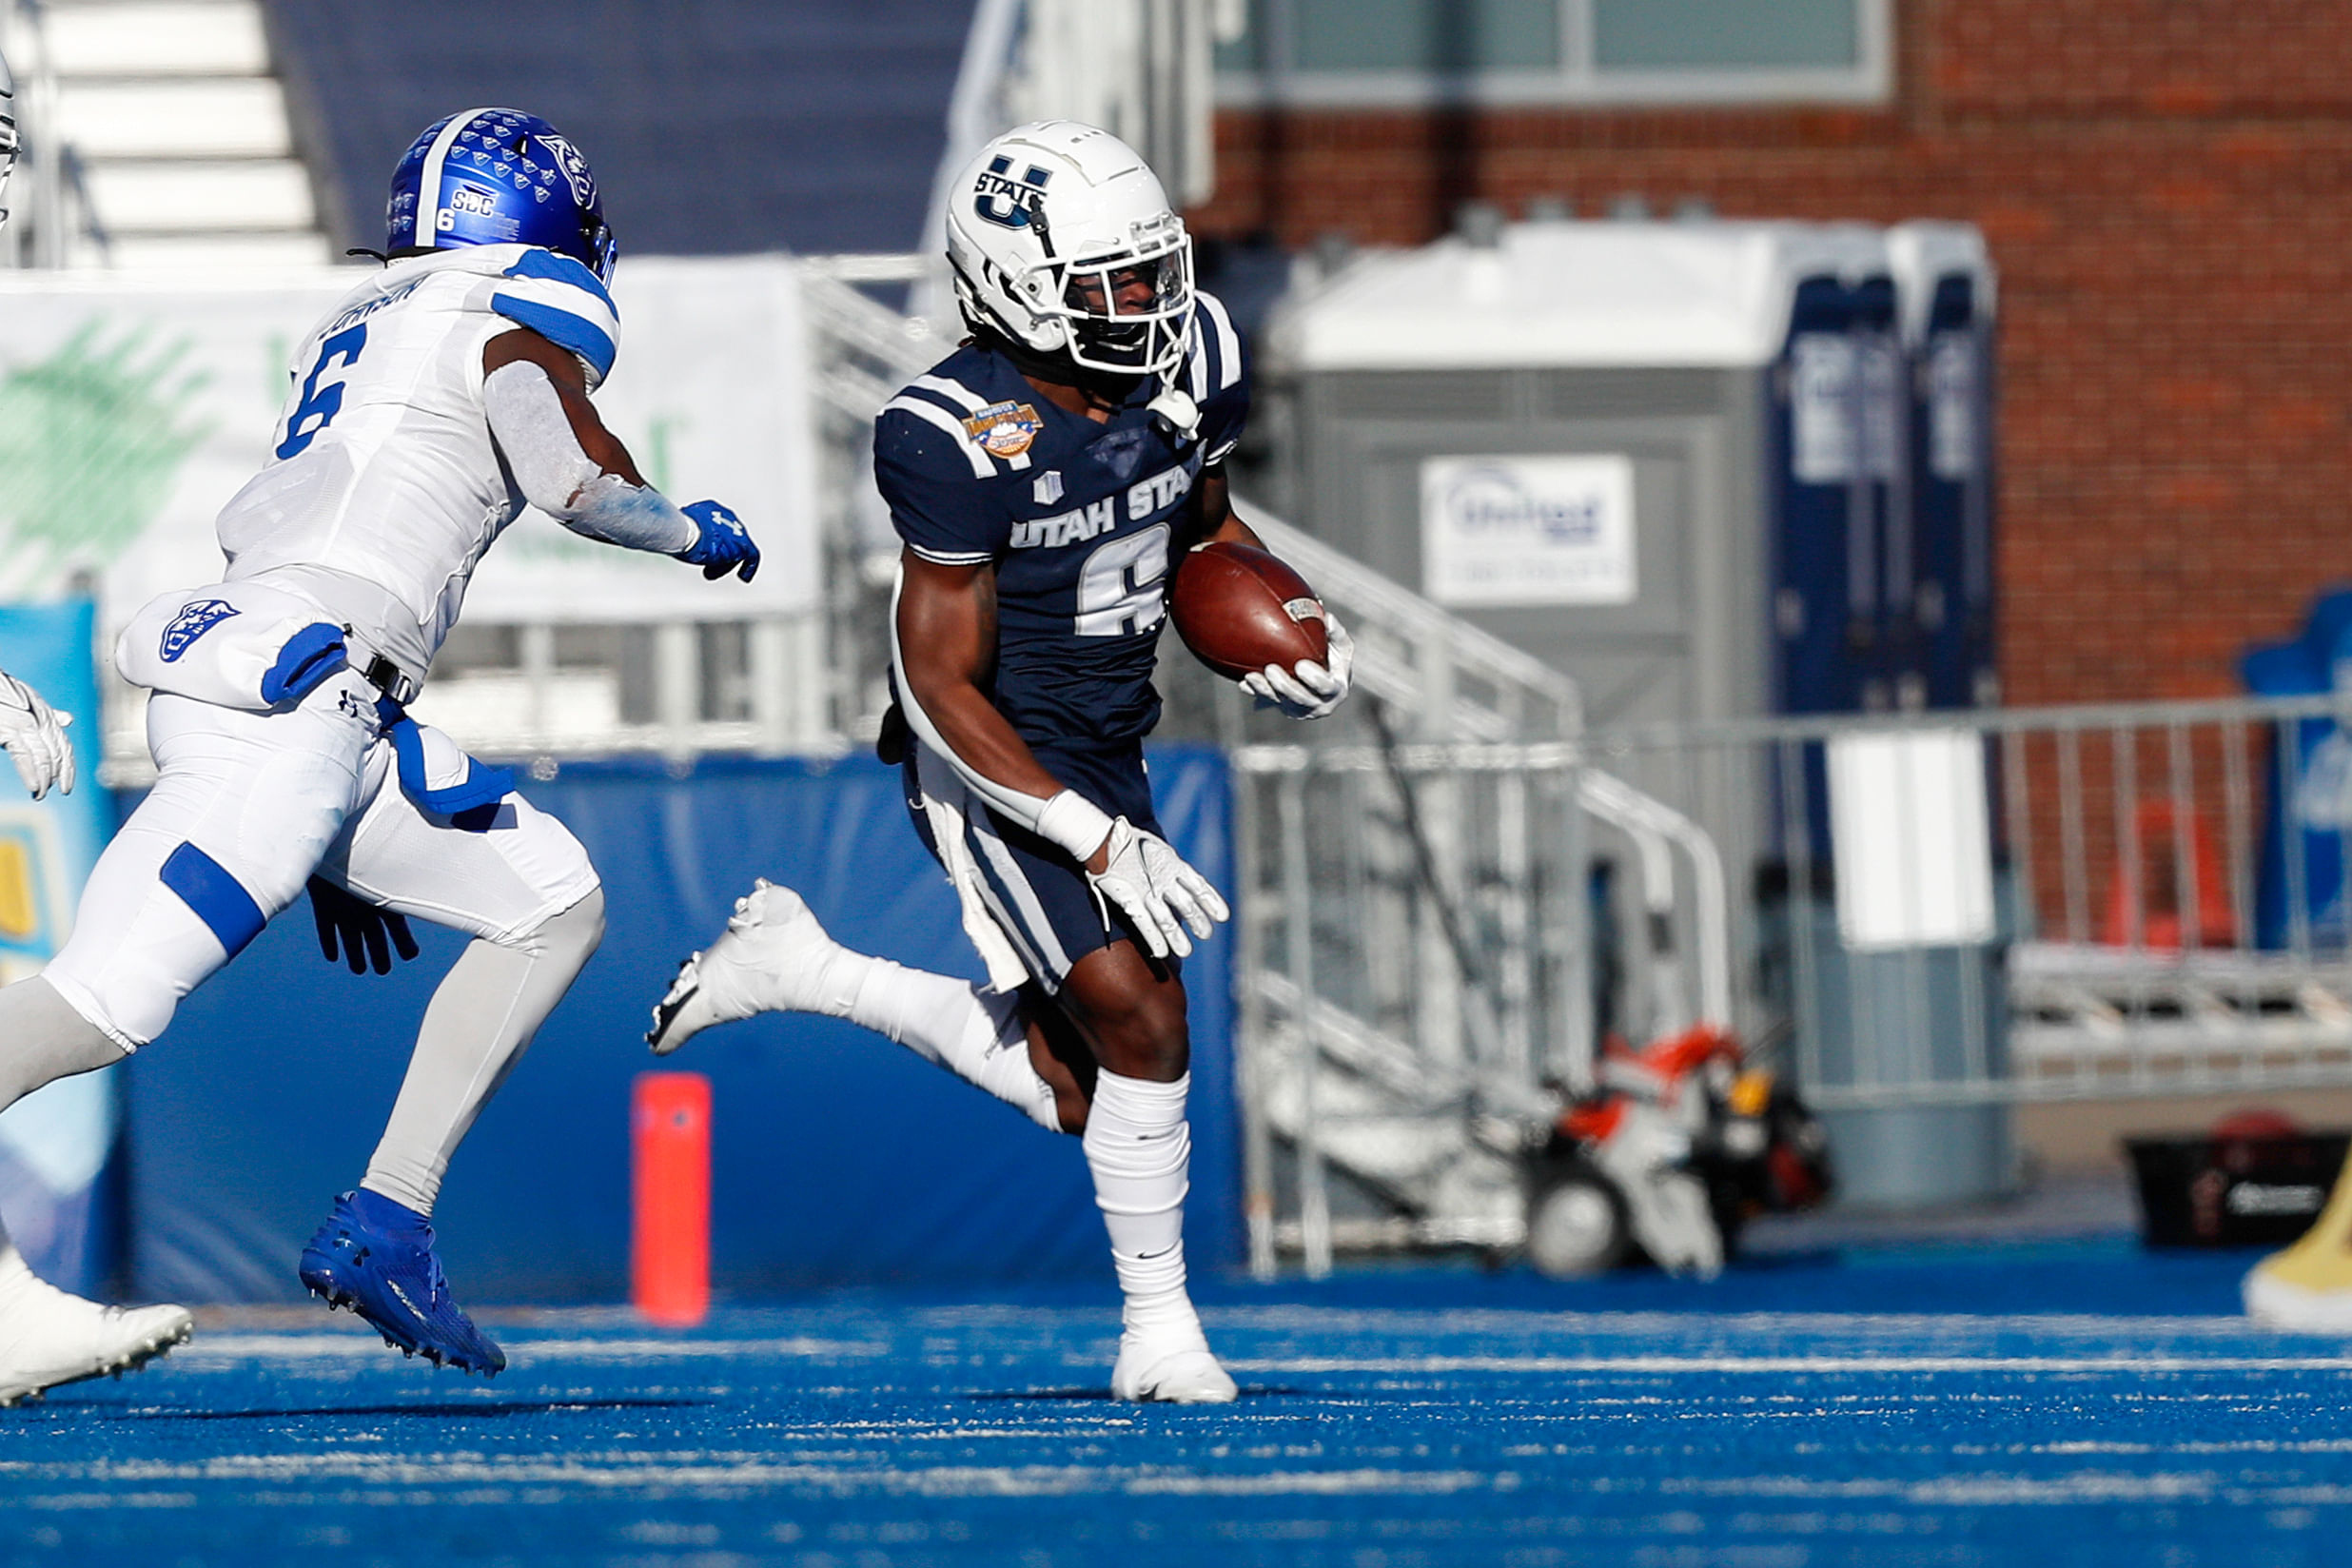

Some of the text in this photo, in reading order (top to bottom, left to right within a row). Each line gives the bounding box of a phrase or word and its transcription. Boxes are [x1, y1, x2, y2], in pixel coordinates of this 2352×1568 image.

[436, 207, 456, 232] 6
[973, 172, 1048, 206] STAT
[276, 322, 368, 461] 6
[1009, 457, 1195, 549] UTAH STA
